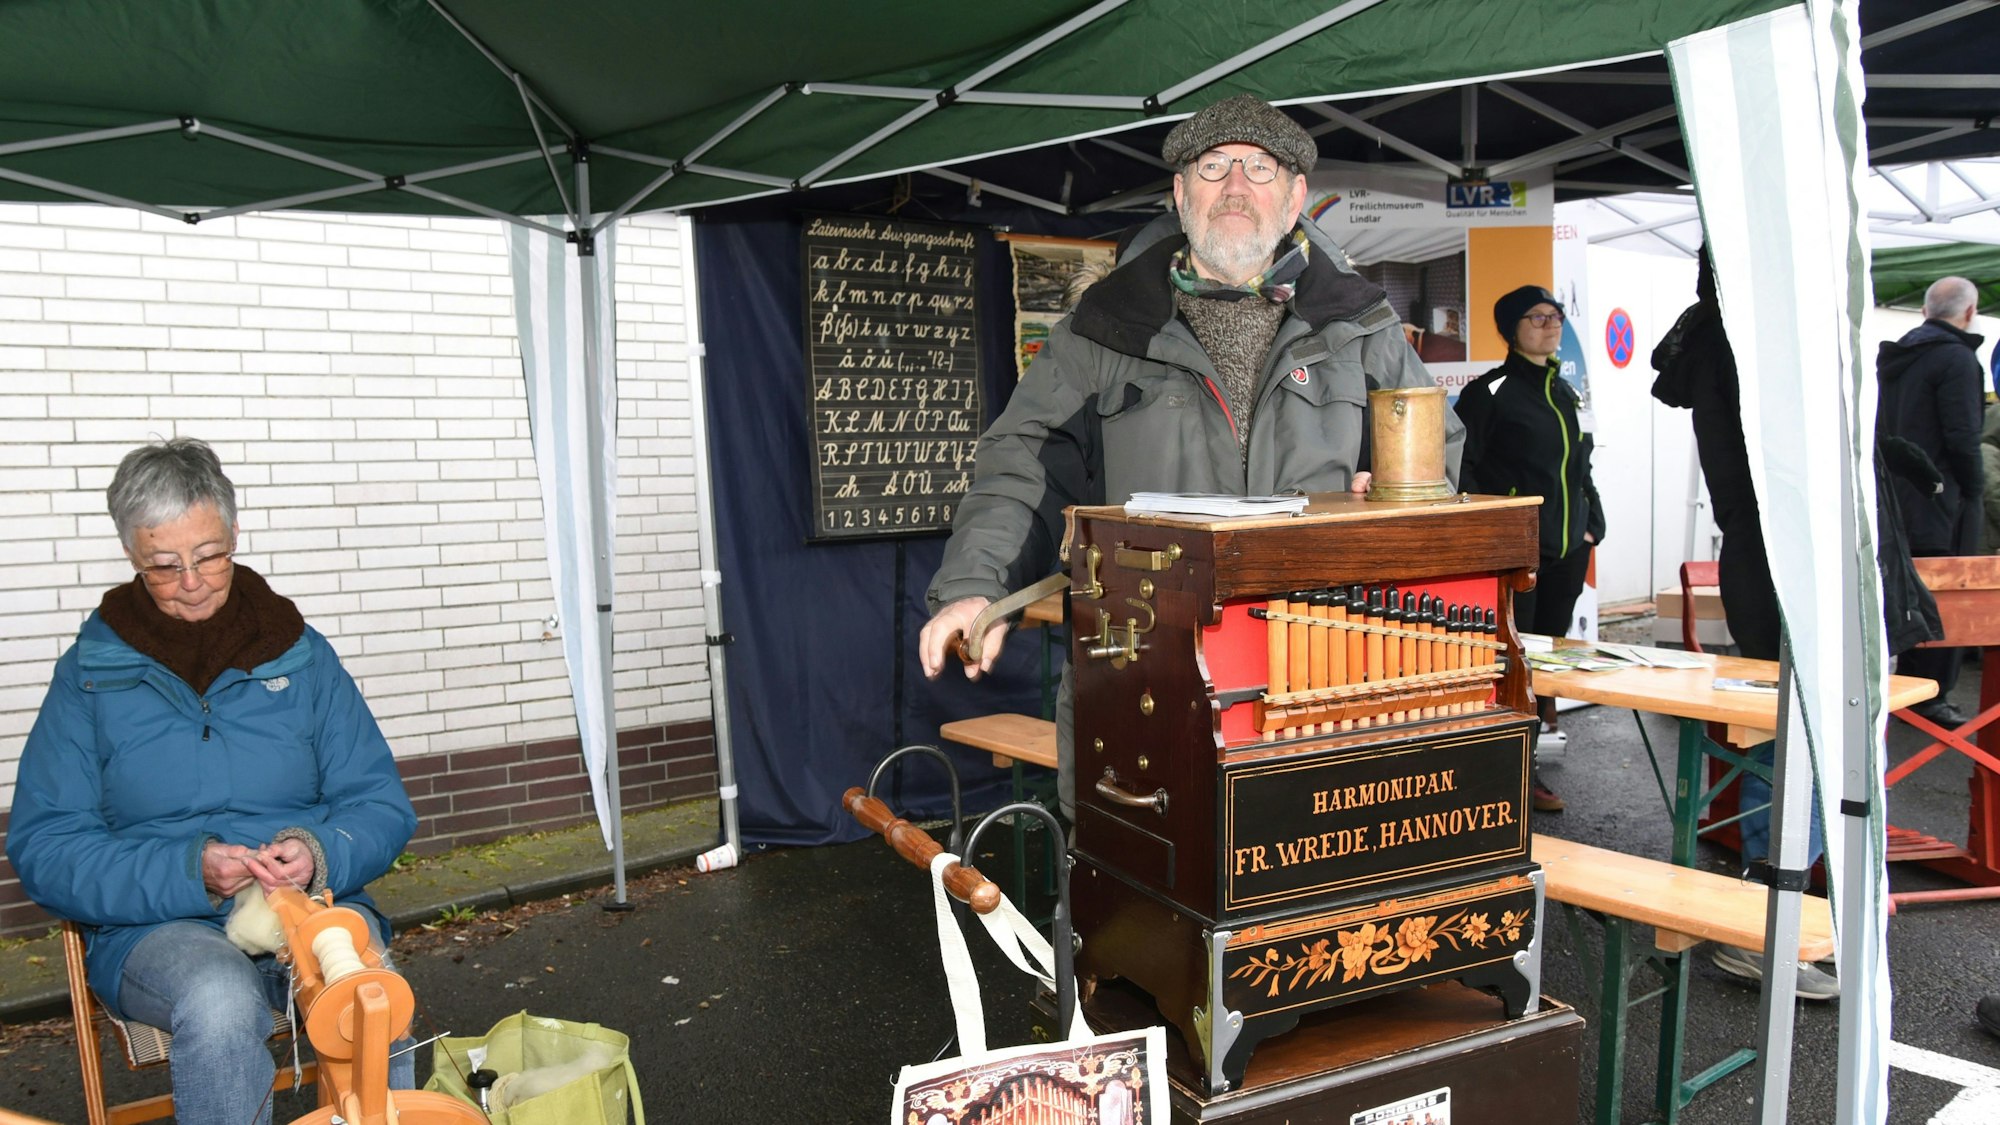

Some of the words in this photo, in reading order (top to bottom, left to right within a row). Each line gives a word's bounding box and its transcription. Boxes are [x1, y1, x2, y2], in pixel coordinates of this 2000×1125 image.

[1350, 190, 1370, 198] LVR-
[1451, 186, 1495, 205] LVR
[1350, 201, 1424, 211] Freilichtmuseum
[1446, 210, 1475, 218] Qualität
[1490, 209, 1527, 217] Menschen
[1350, 215, 1381, 223] Lindlar
[808, 218, 876, 239] Lateinische
[1553, 224, 1578, 240] EEN
[827, 512, 835, 528] 1
[844, 511, 854, 527] 2
[862, 509, 871, 526] 3
[878, 509, 888, 525] 4
[895, 508, 904, 524] 5
[911, 507, 920, 523] 6
[927, 506, 936, 521] 7
[943, 505, 950, 521] 8
[1312, 769, 1458, 814] HARMONIPAN.
[1234, 845, 1274, 876] FR.
[1275, 826, 1377, 867] WREDE,
[1379, 801, 1517, 849] HANNOVER.
